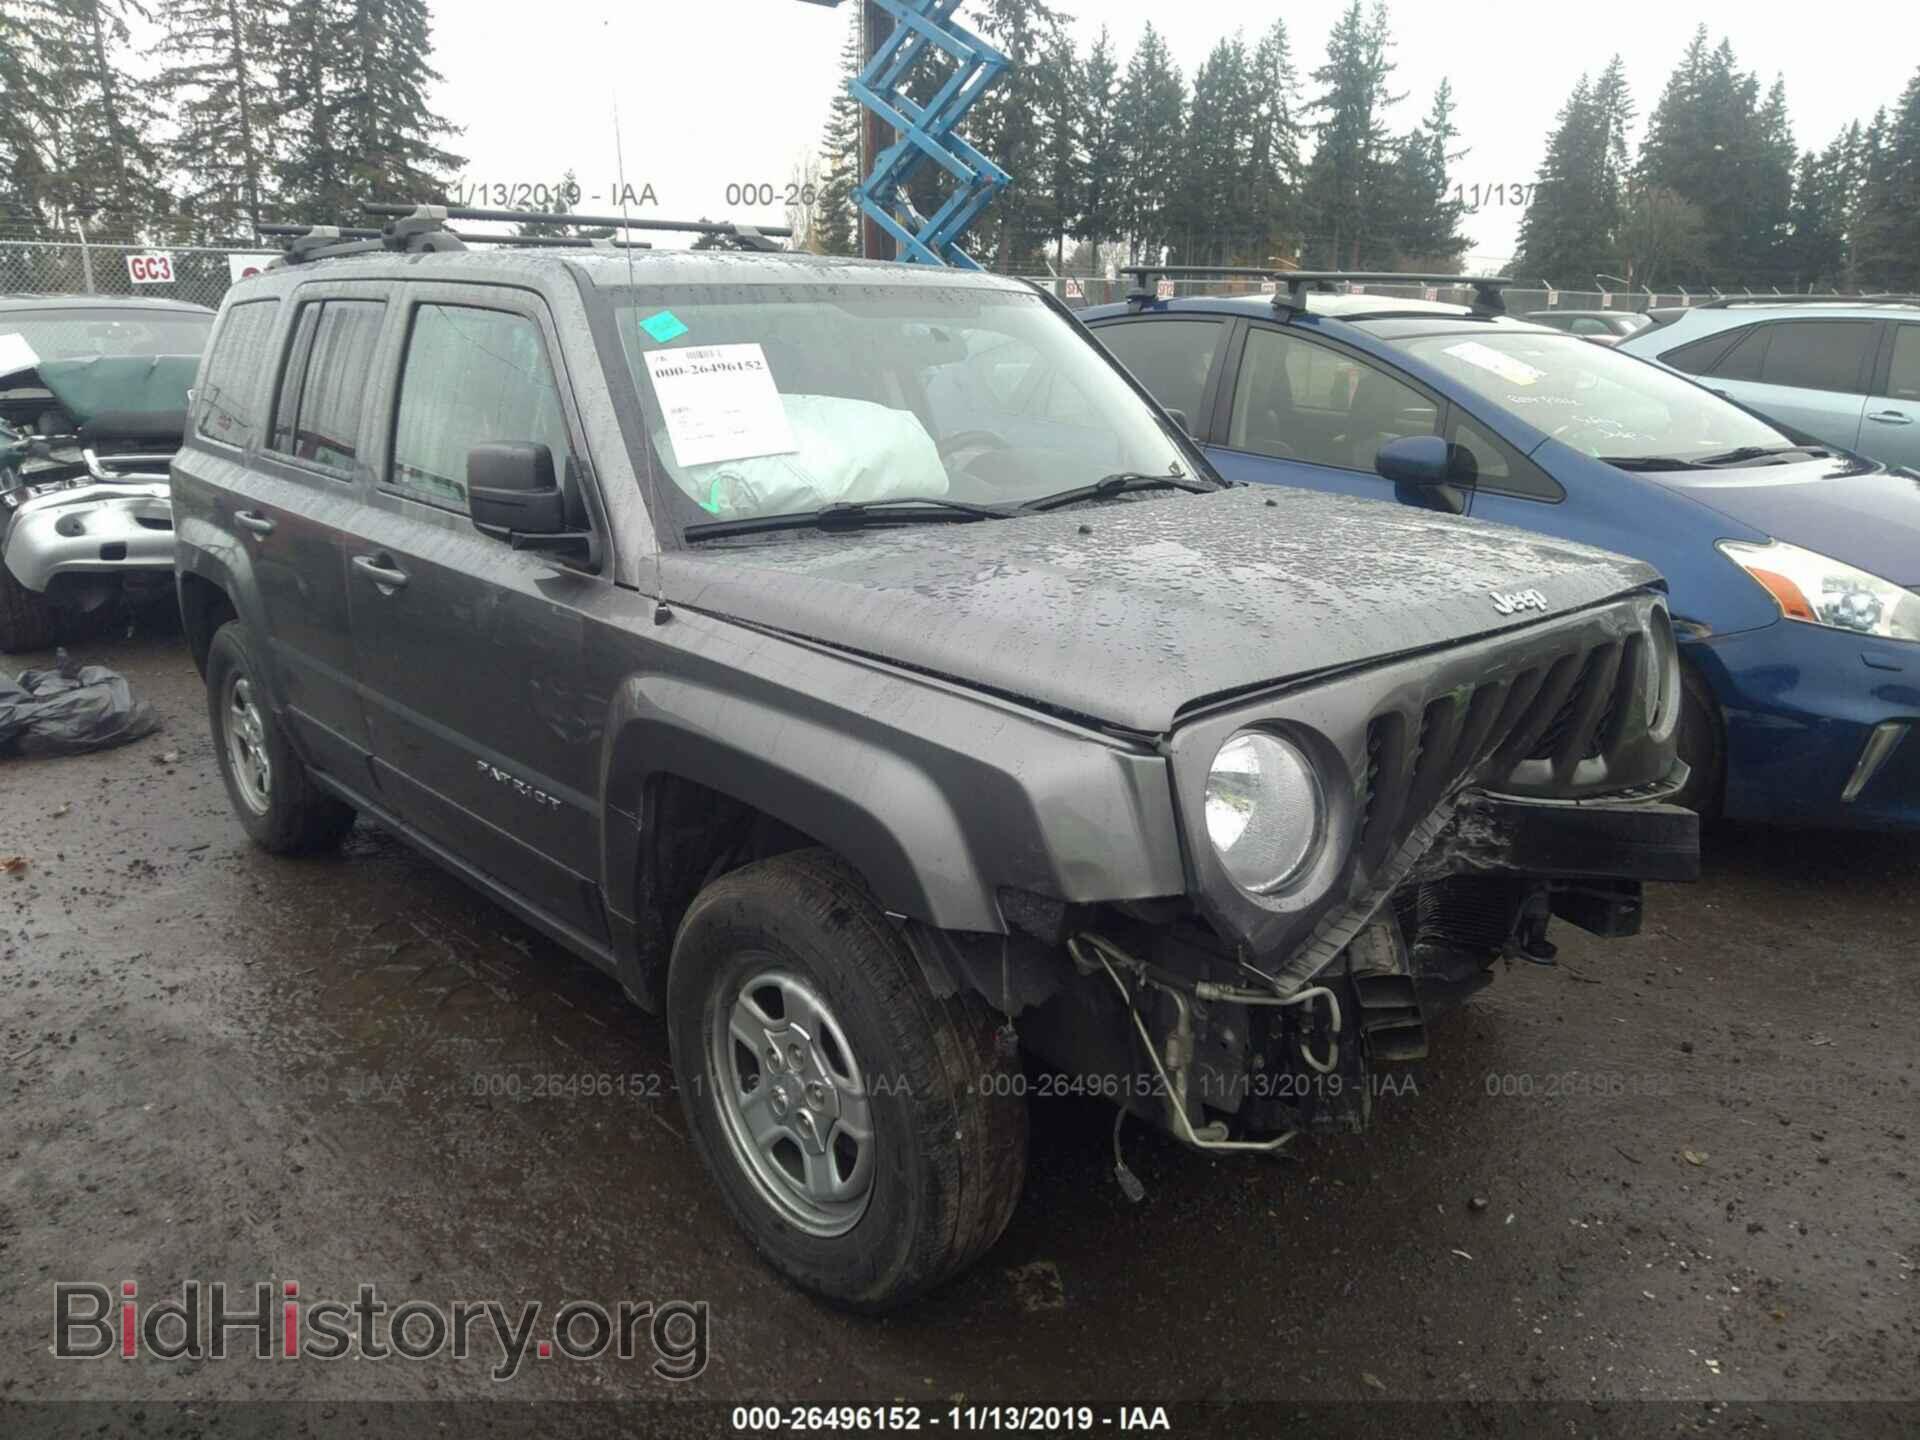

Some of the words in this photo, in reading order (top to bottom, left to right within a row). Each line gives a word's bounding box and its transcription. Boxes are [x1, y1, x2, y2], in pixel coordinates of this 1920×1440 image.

[131, 257, 170, 280] GC3
[655, 360, 764, 378] 000-26496152
[1489, 588, 1548, 614] Jeep
[477, 760, 562, 811] PATRIOT
